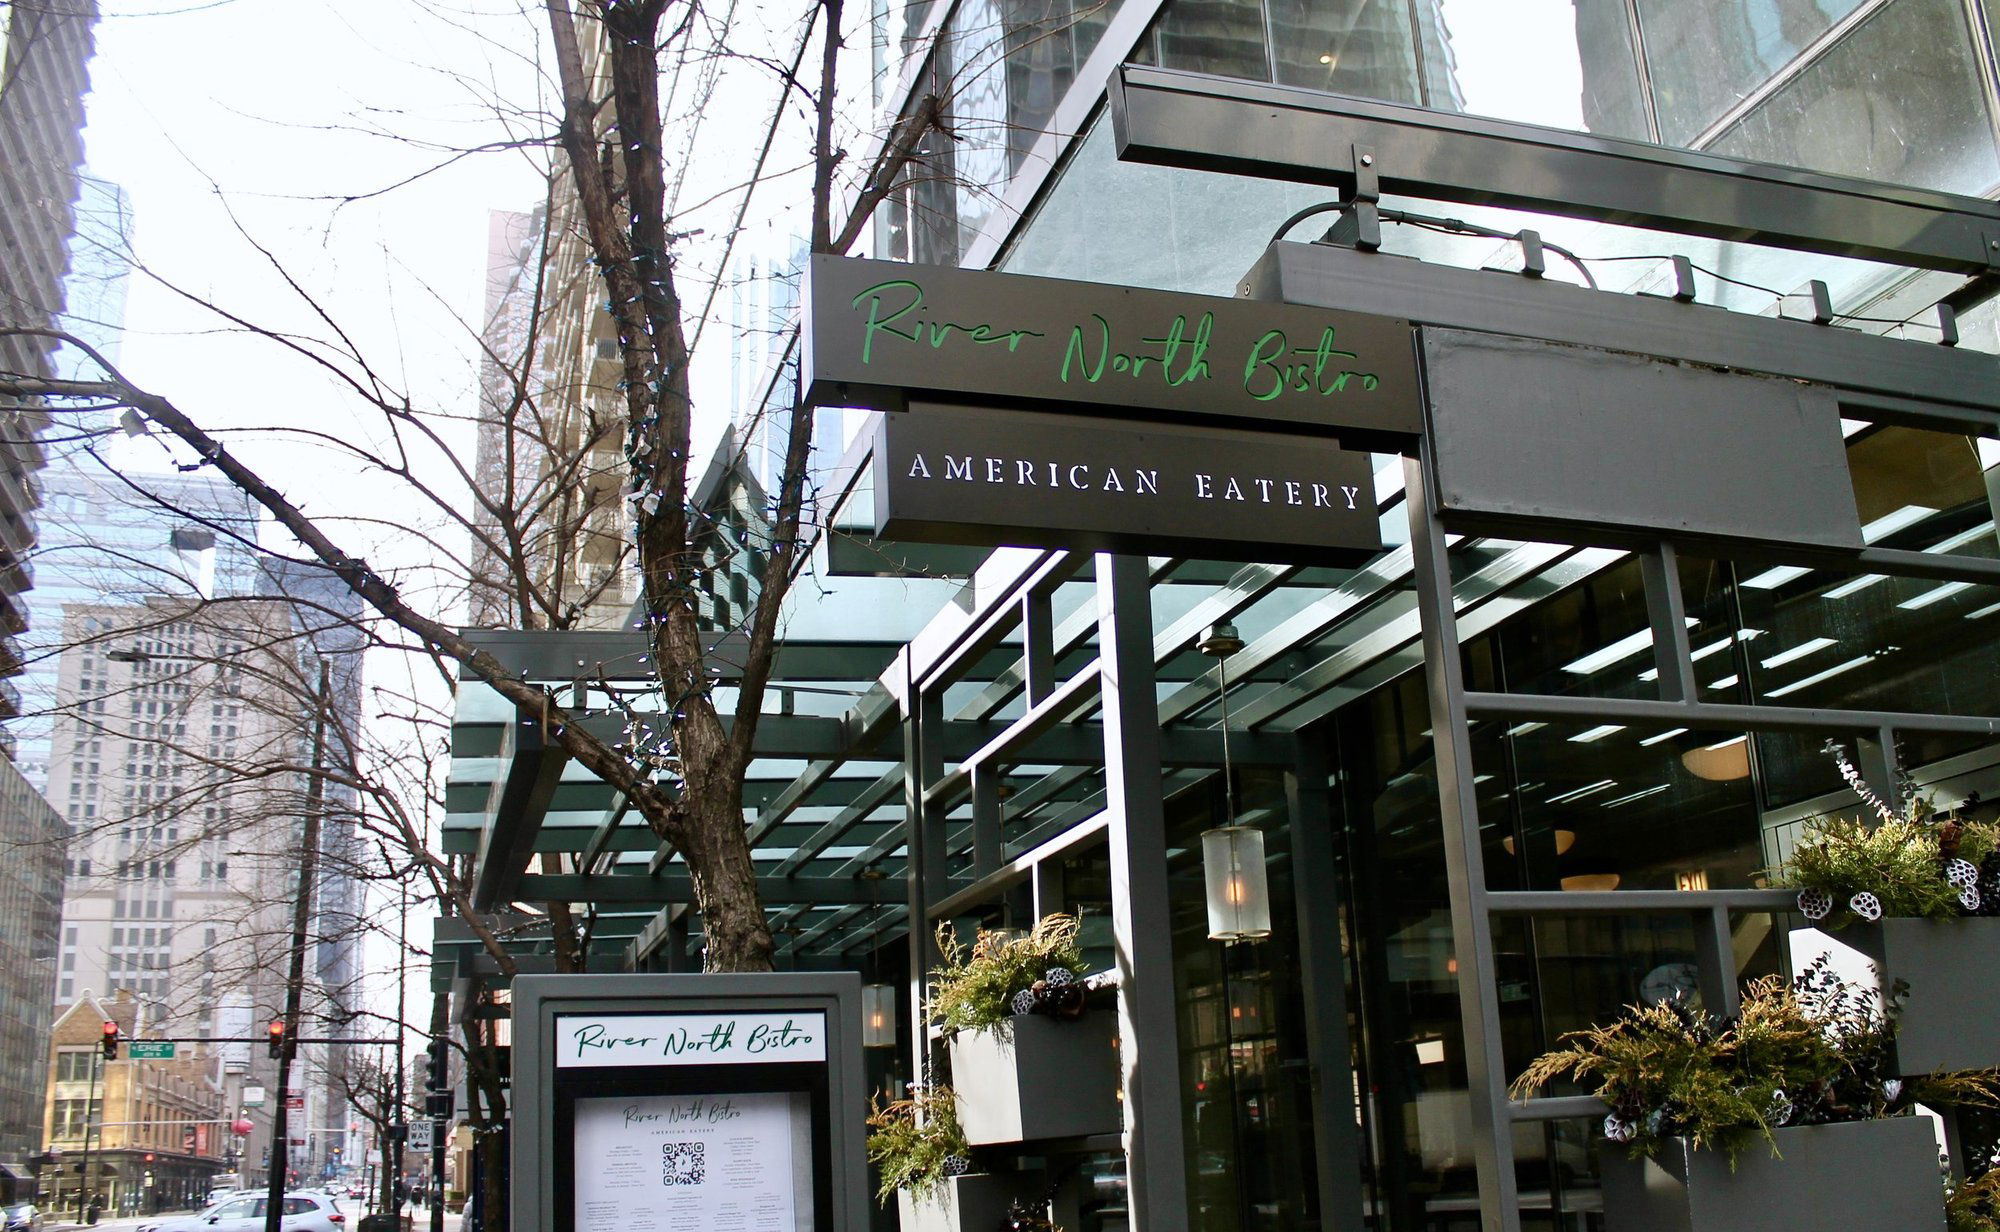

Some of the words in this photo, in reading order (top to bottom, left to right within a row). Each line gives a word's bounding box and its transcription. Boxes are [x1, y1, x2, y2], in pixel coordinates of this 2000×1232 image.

[852, 279, 1044, 364] River
[1061, 311, 1212, 387] North
[1244, 326, 1379, 401] Bistro
[908, 453, 1158, 495] AMERICAN
[1195, 474, 1359, 510] EATERY
[574, 1024, 657, 1058] River
[664, 1020, 736, 1056] North
[747, 1019, 813, 1053] Bistro
[411, 1123, 429, 1131] ONE
[623, 1104, 663, 1129] River
[669, 1099, 703, 1124] North
[709, 1099, 741, 1124] Bistro
[411, 1132, 430, 1140] WAY
